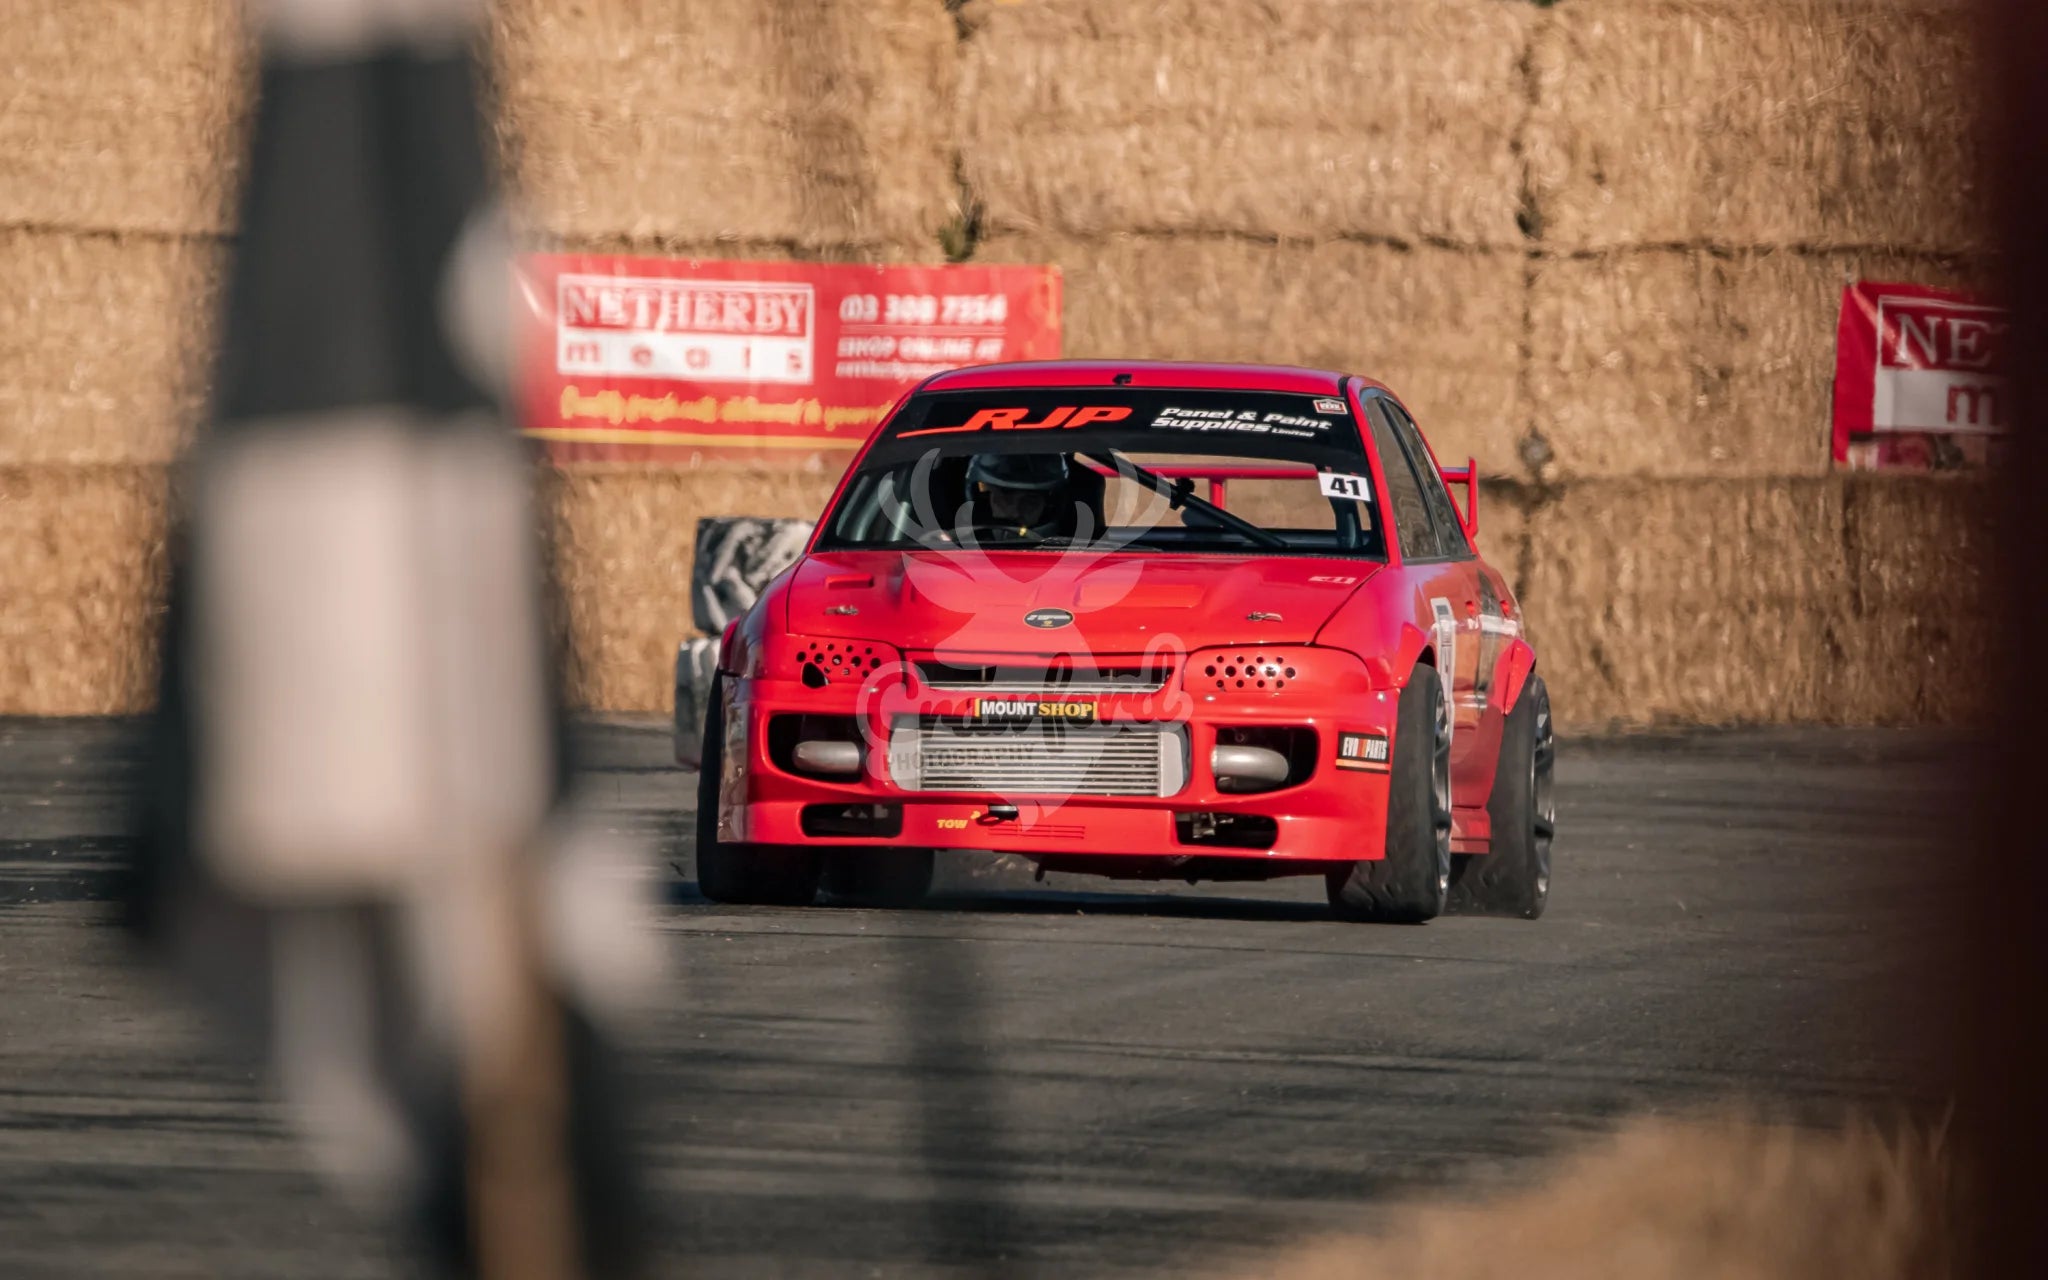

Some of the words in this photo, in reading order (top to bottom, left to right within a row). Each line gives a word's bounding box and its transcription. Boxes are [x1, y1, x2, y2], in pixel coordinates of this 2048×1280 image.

[563, 285, 806, 333] NETHERBY
[839, 294, 878, 322] 03
[566, 342, 803, 371] meals
[962, 406, 1131, 431] RJP
[1151, 417, 1271, 433] Supplies
[1271, 428, 1315, 438] Limited
[1160, 407, 1236, 420] Panel
[1236, 411, 1257, 422] &
[1263, 413, 1332, 430] Paint
[1330, 477, 1361, 497] 41
[981, 701, 1037, 716] MOUNT
[1038, 703, 1093, 718] SHOP
[936, 819, 968, 829] TOW
